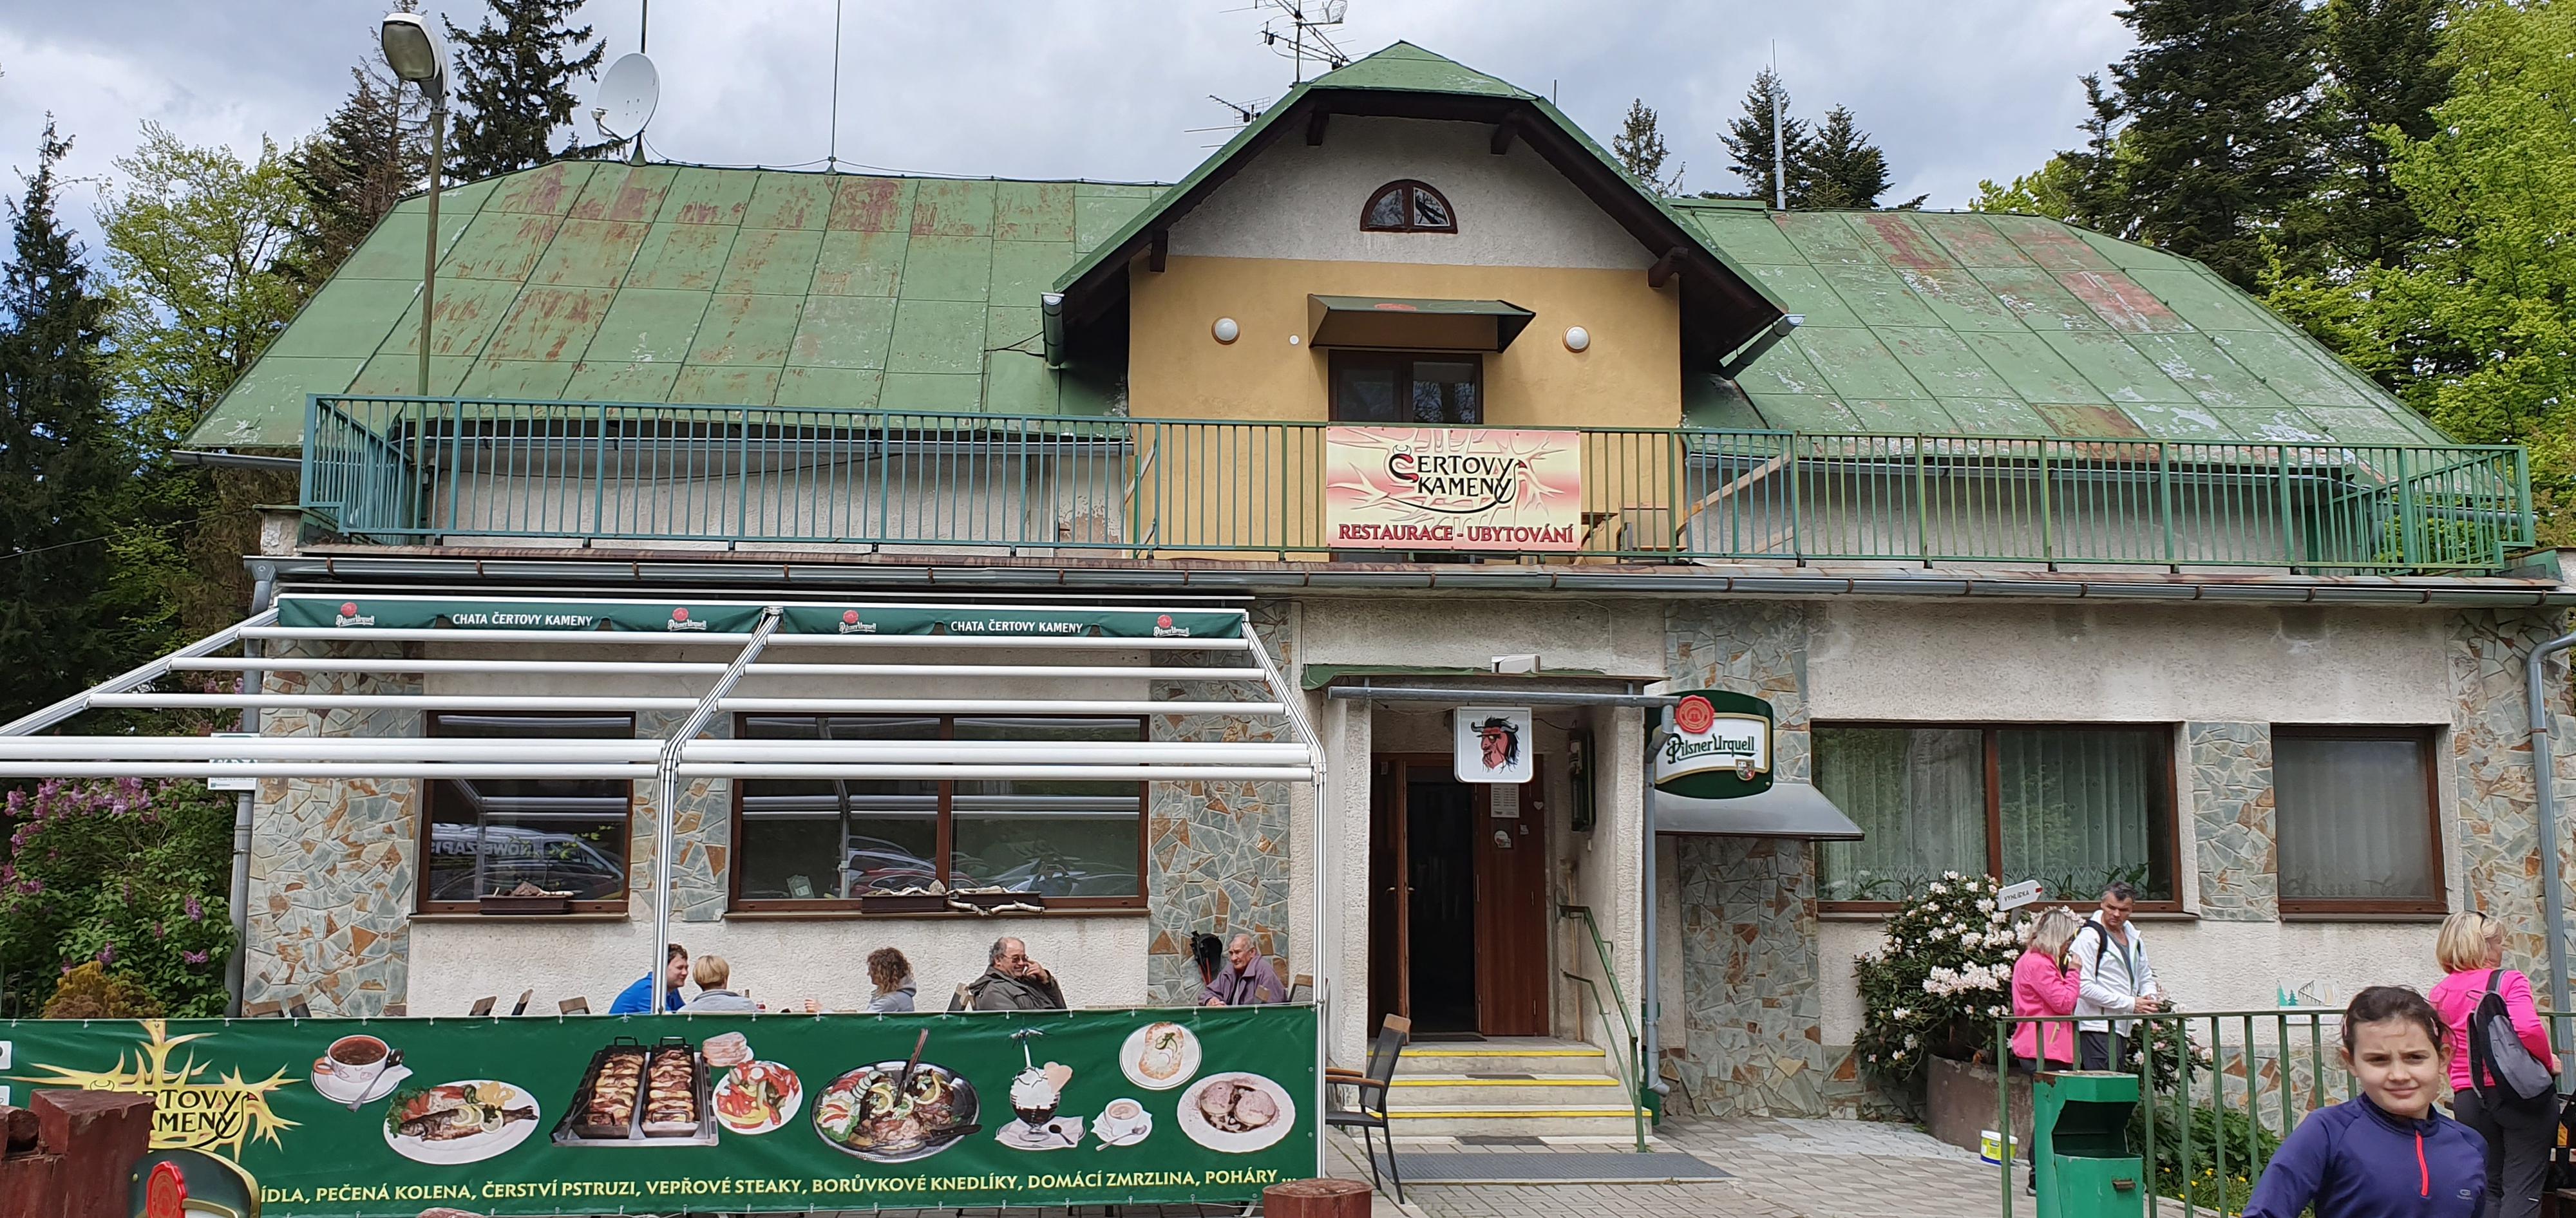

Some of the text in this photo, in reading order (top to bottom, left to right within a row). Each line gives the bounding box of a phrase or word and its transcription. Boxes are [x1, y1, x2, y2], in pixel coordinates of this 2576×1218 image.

[1417, 477, 1513, 501] KAMENY
[1338, 524, 1453, 541] RESTAURACE
[1468, 523, 1574, 543] UBYTOVÁNÍ
[452, 612, 592, 626] CHATA ČERTOVY KAMENY
[951, 619, 1083, 633] CHATA ČERTOVY KAMENY
[1666, 733, 1754, 764] Pilsner Urquell
[142, 1089, 242, 1113] TOVY
[158, 1112, 240, 1136] MENY
[261, 1186, 310, 1204] ÍDLA,
[316, 1183, 388, 1201] PEČENÁ
[395, 1185, 477, 1201] KOLENA,
[482, 1179, 558, 1198] ČERSTVÍ
[562, 1182, 641, 1197] PSTRUZI,
[646, 1177, 732, 1195] VEPŘOVÉ
[735, 1179, 808, 1195] STEAKY,
[812, 1174, 927, 1193] BORŮVKOVÉ
[931, 1173, 1023, 1191] KNEDLÍKY,
[1028, 1170, 1103, 1188] DOMÁCÍ
[1106, 1171, 1200, 1187] ZMRZLINA,
[1205, 1167, 1278, 1185] POHÁRY
